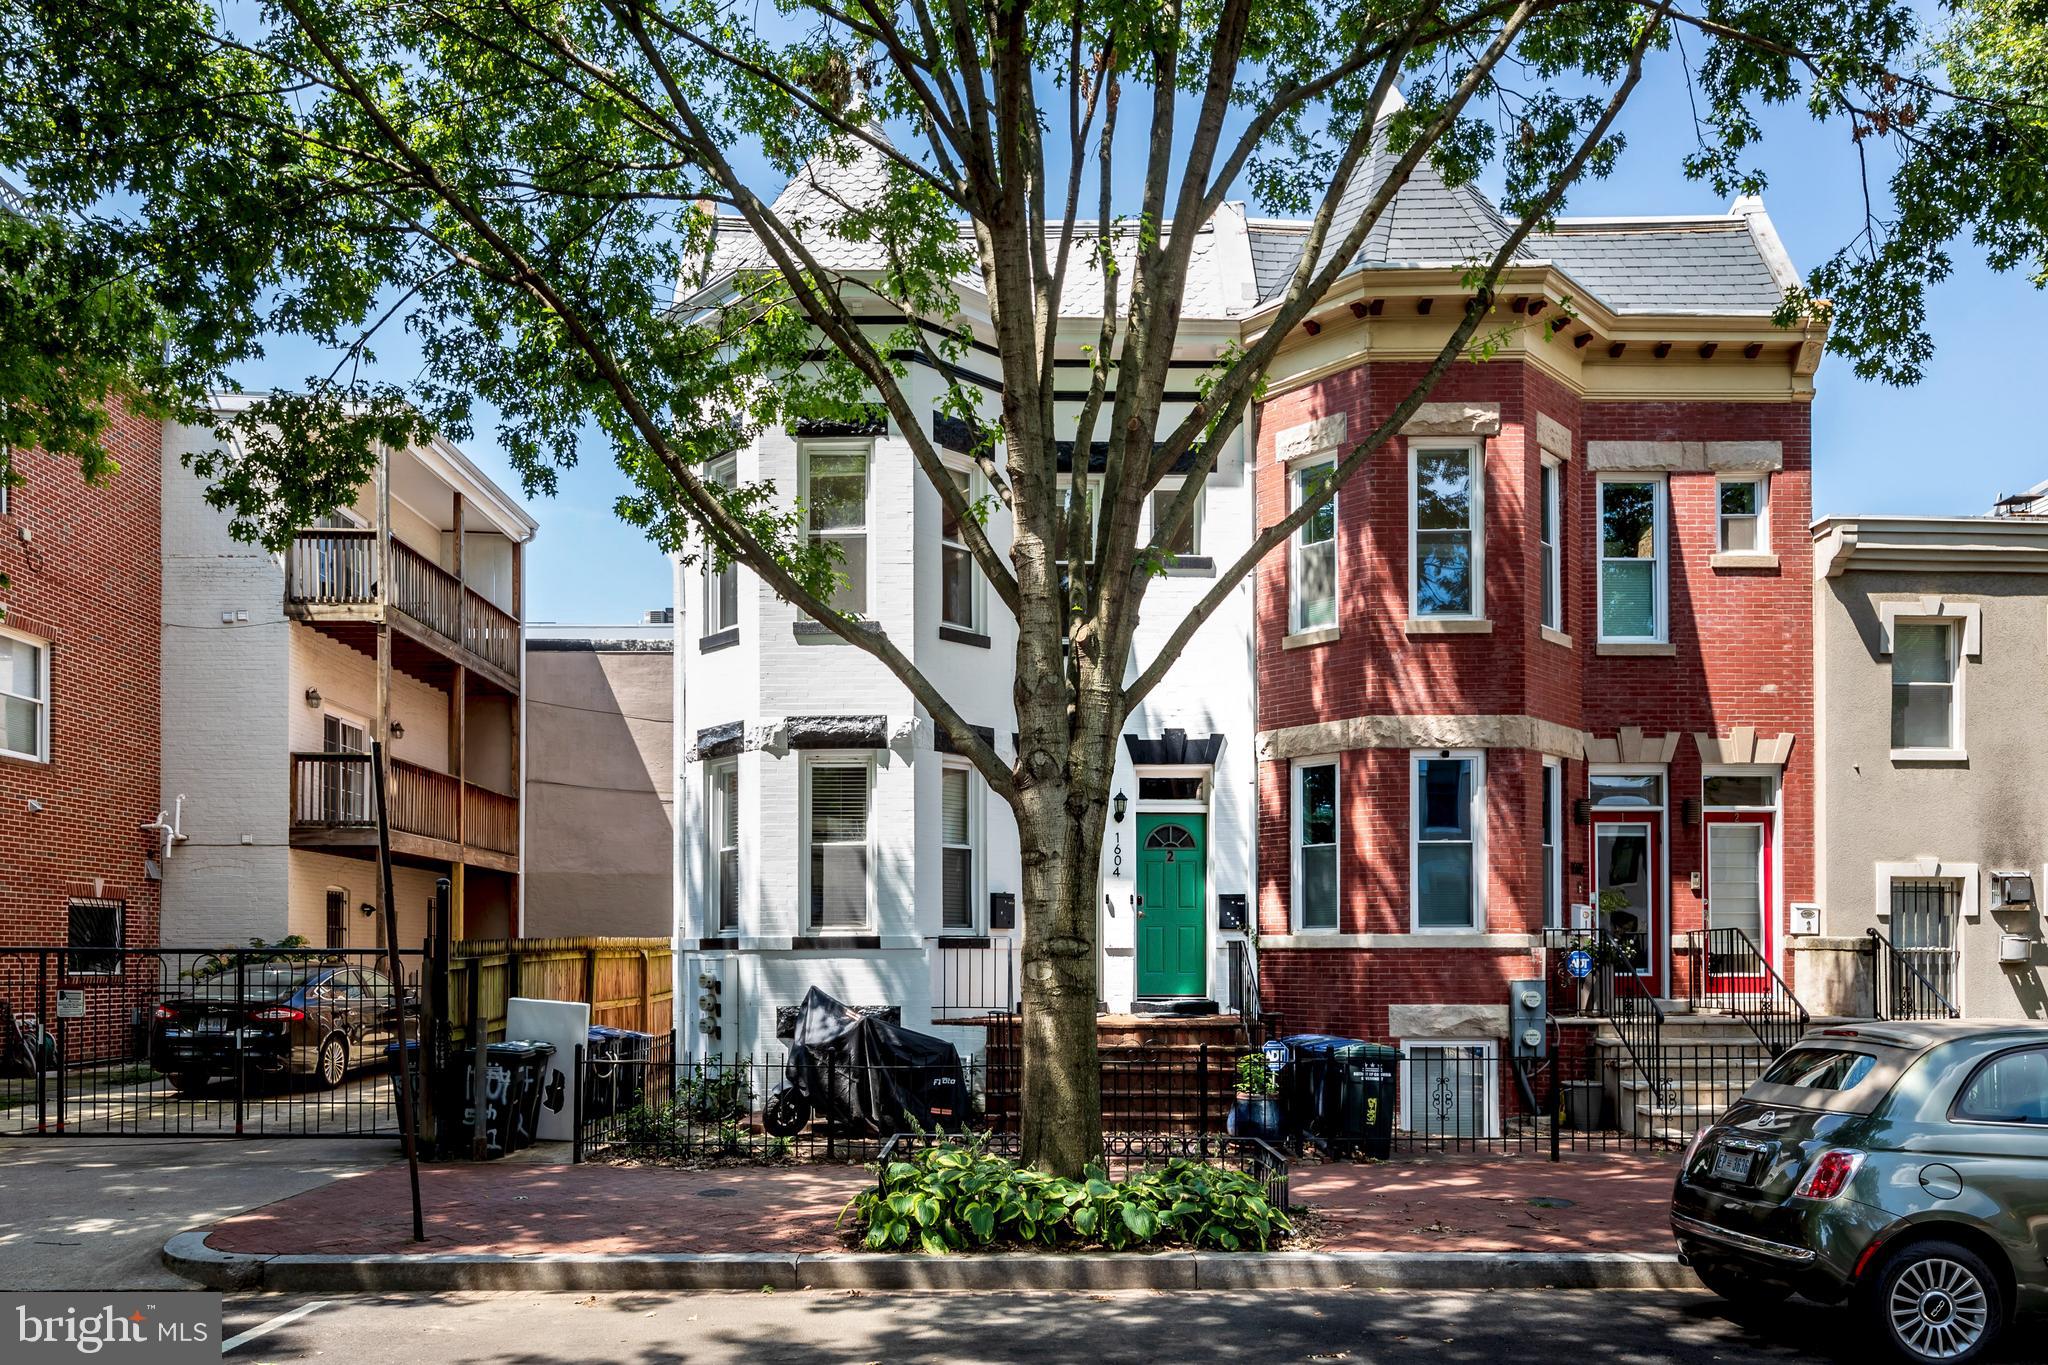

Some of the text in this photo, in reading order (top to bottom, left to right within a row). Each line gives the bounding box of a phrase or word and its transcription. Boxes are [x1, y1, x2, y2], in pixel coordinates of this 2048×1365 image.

[1113, 832, 1121, 877] 1604
[1167, 850, 1174, 862] 2
[1569, 959, 1590, 969] ADT
[1266, 1050, 1286, 1062] ADT
